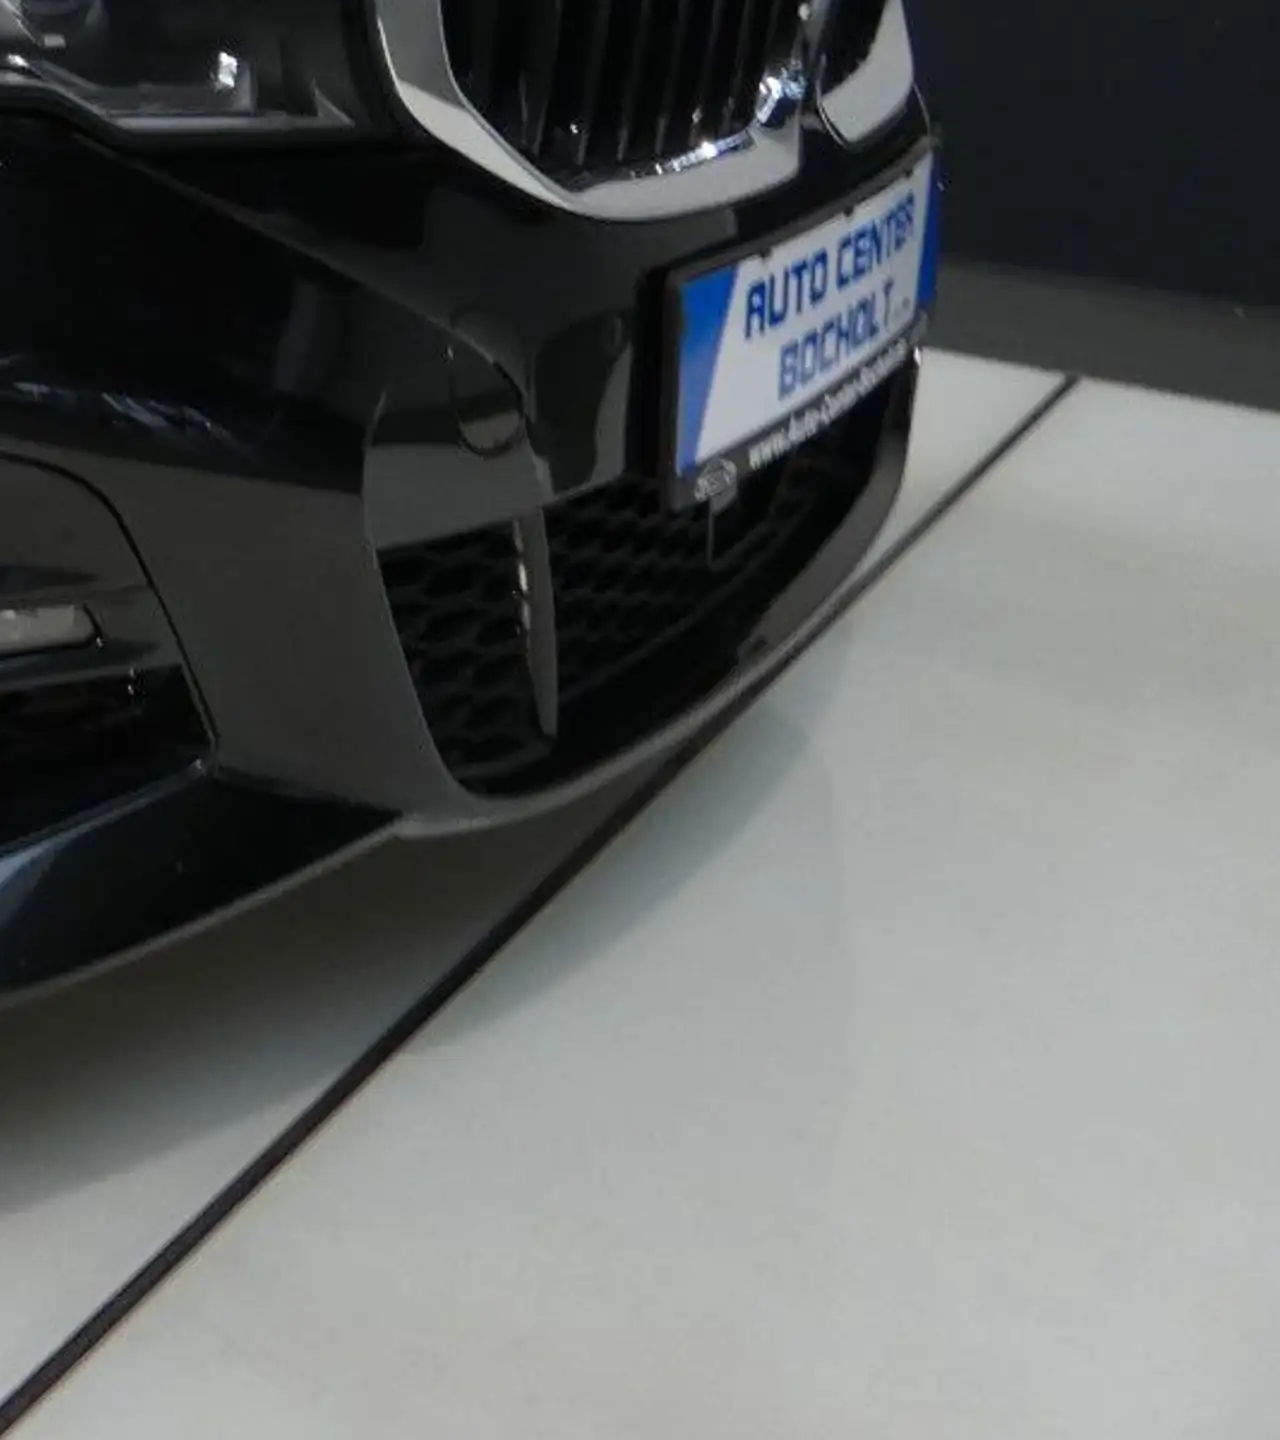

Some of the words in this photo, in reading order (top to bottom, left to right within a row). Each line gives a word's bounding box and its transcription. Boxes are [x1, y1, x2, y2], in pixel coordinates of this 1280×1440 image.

[745, 245, 828, 340] AUTO
[836, 189, 915, 291] CENTER
[778, 276, 895, 400] BOCHOLT
